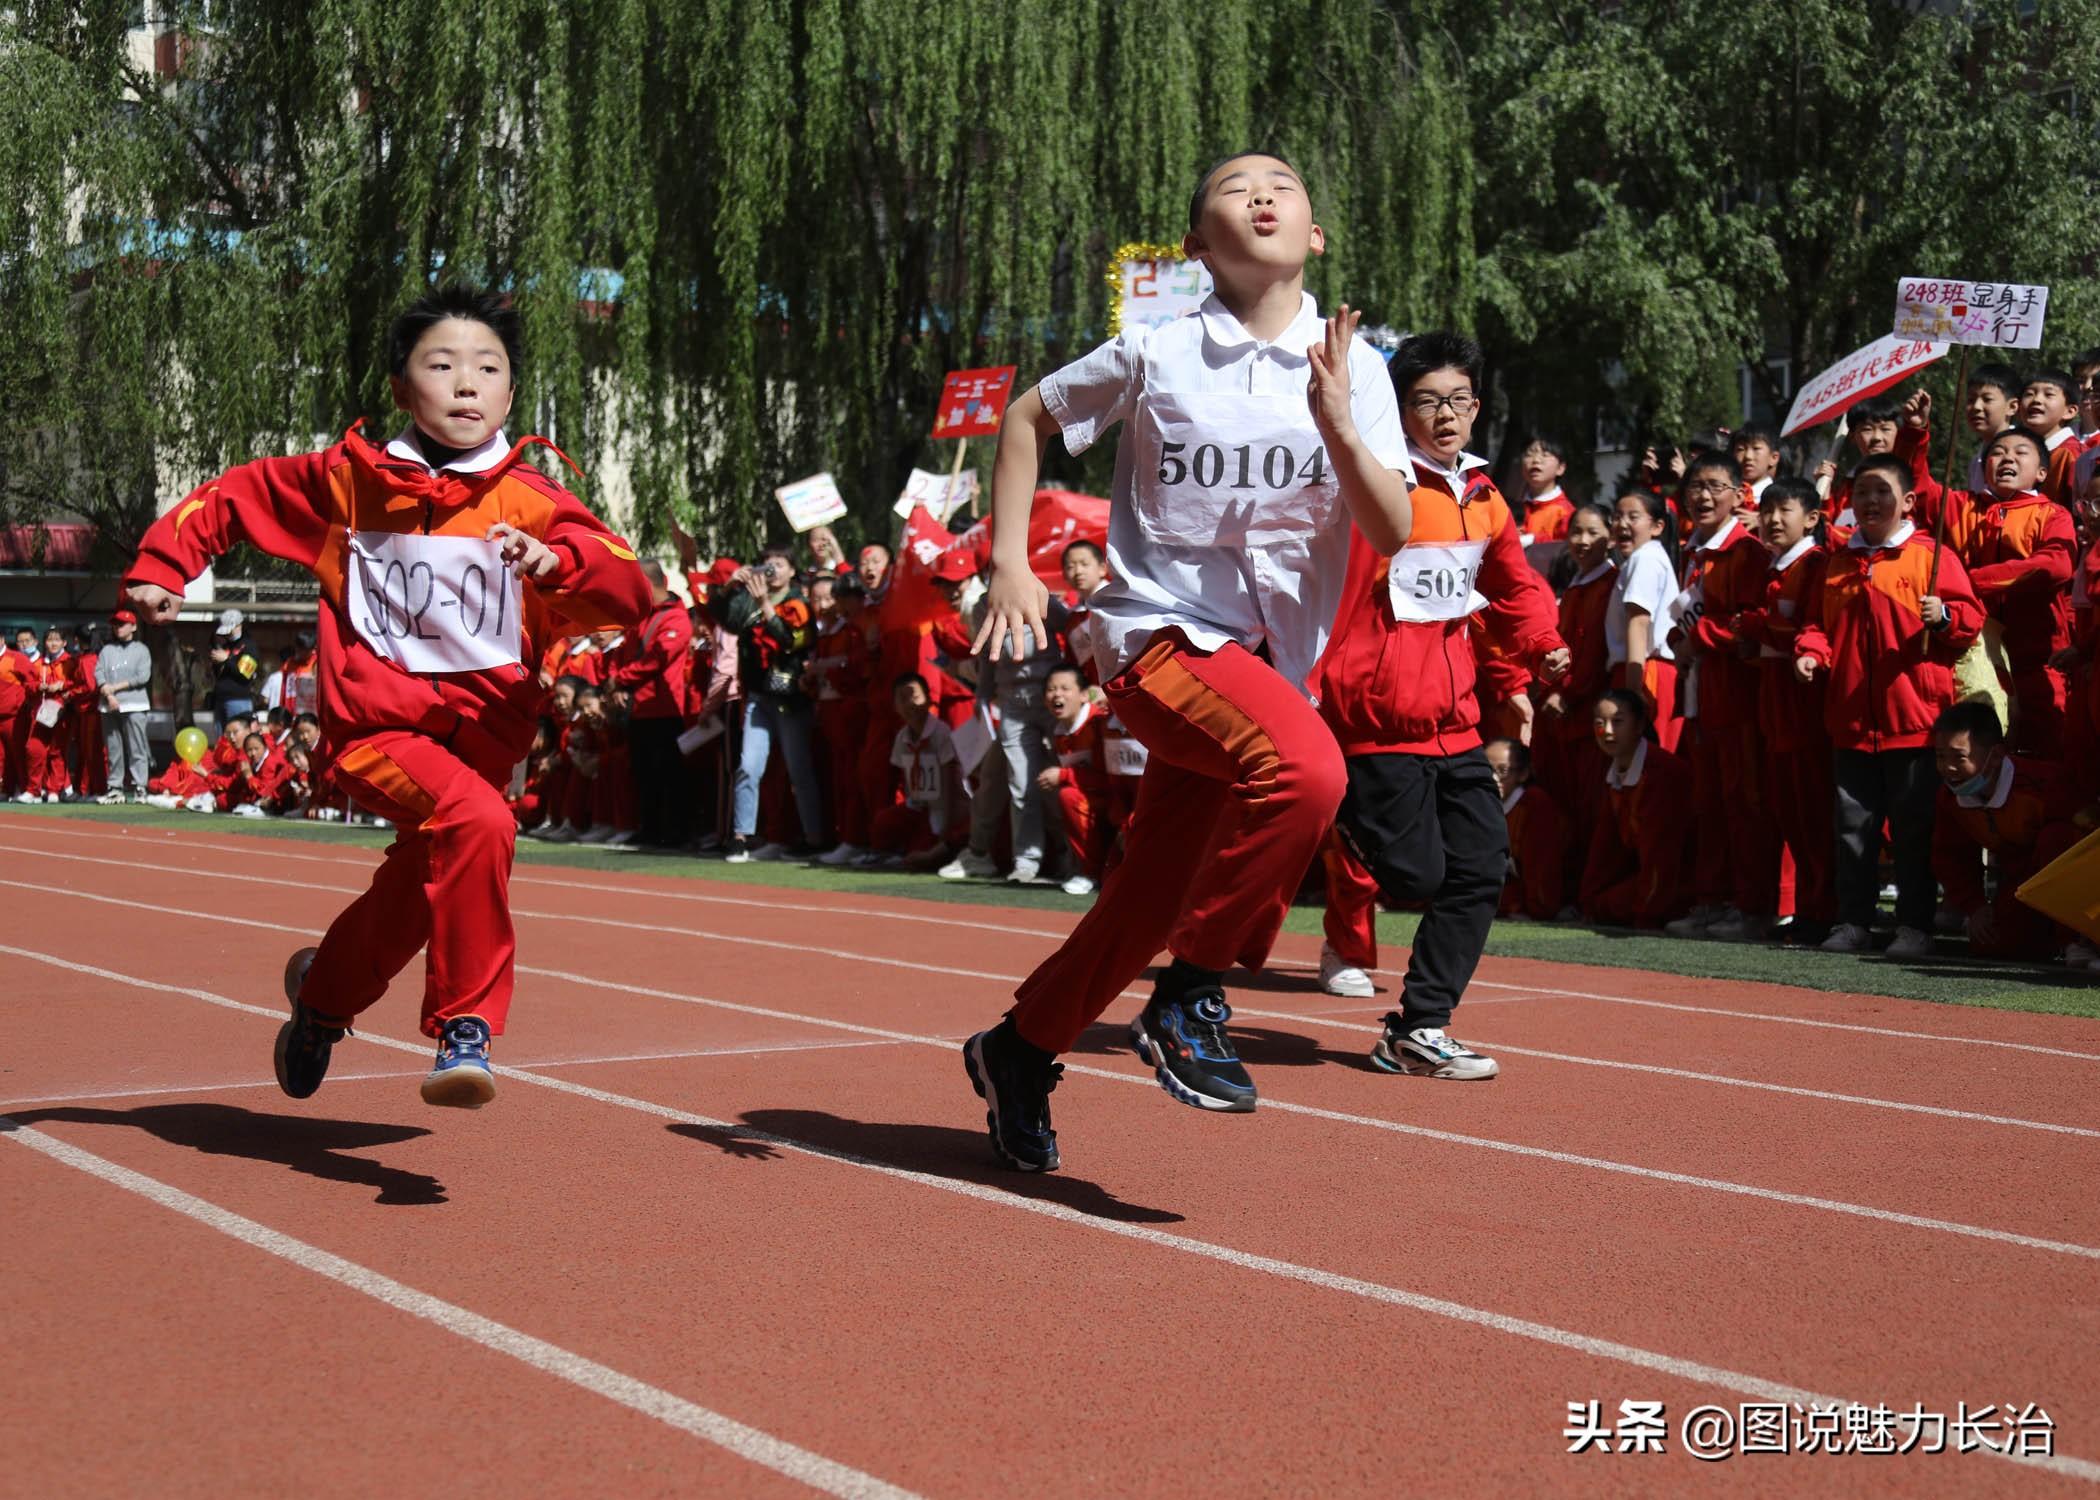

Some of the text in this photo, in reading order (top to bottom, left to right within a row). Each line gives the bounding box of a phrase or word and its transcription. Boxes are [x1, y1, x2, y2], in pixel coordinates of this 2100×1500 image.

[955, 379, 1001, 398] 二五一
[1795, 340, 1933, 420] 248班代表队
[1158, 442, 1328, 490] 50104
[363, 557, 507, 640] 502-01
